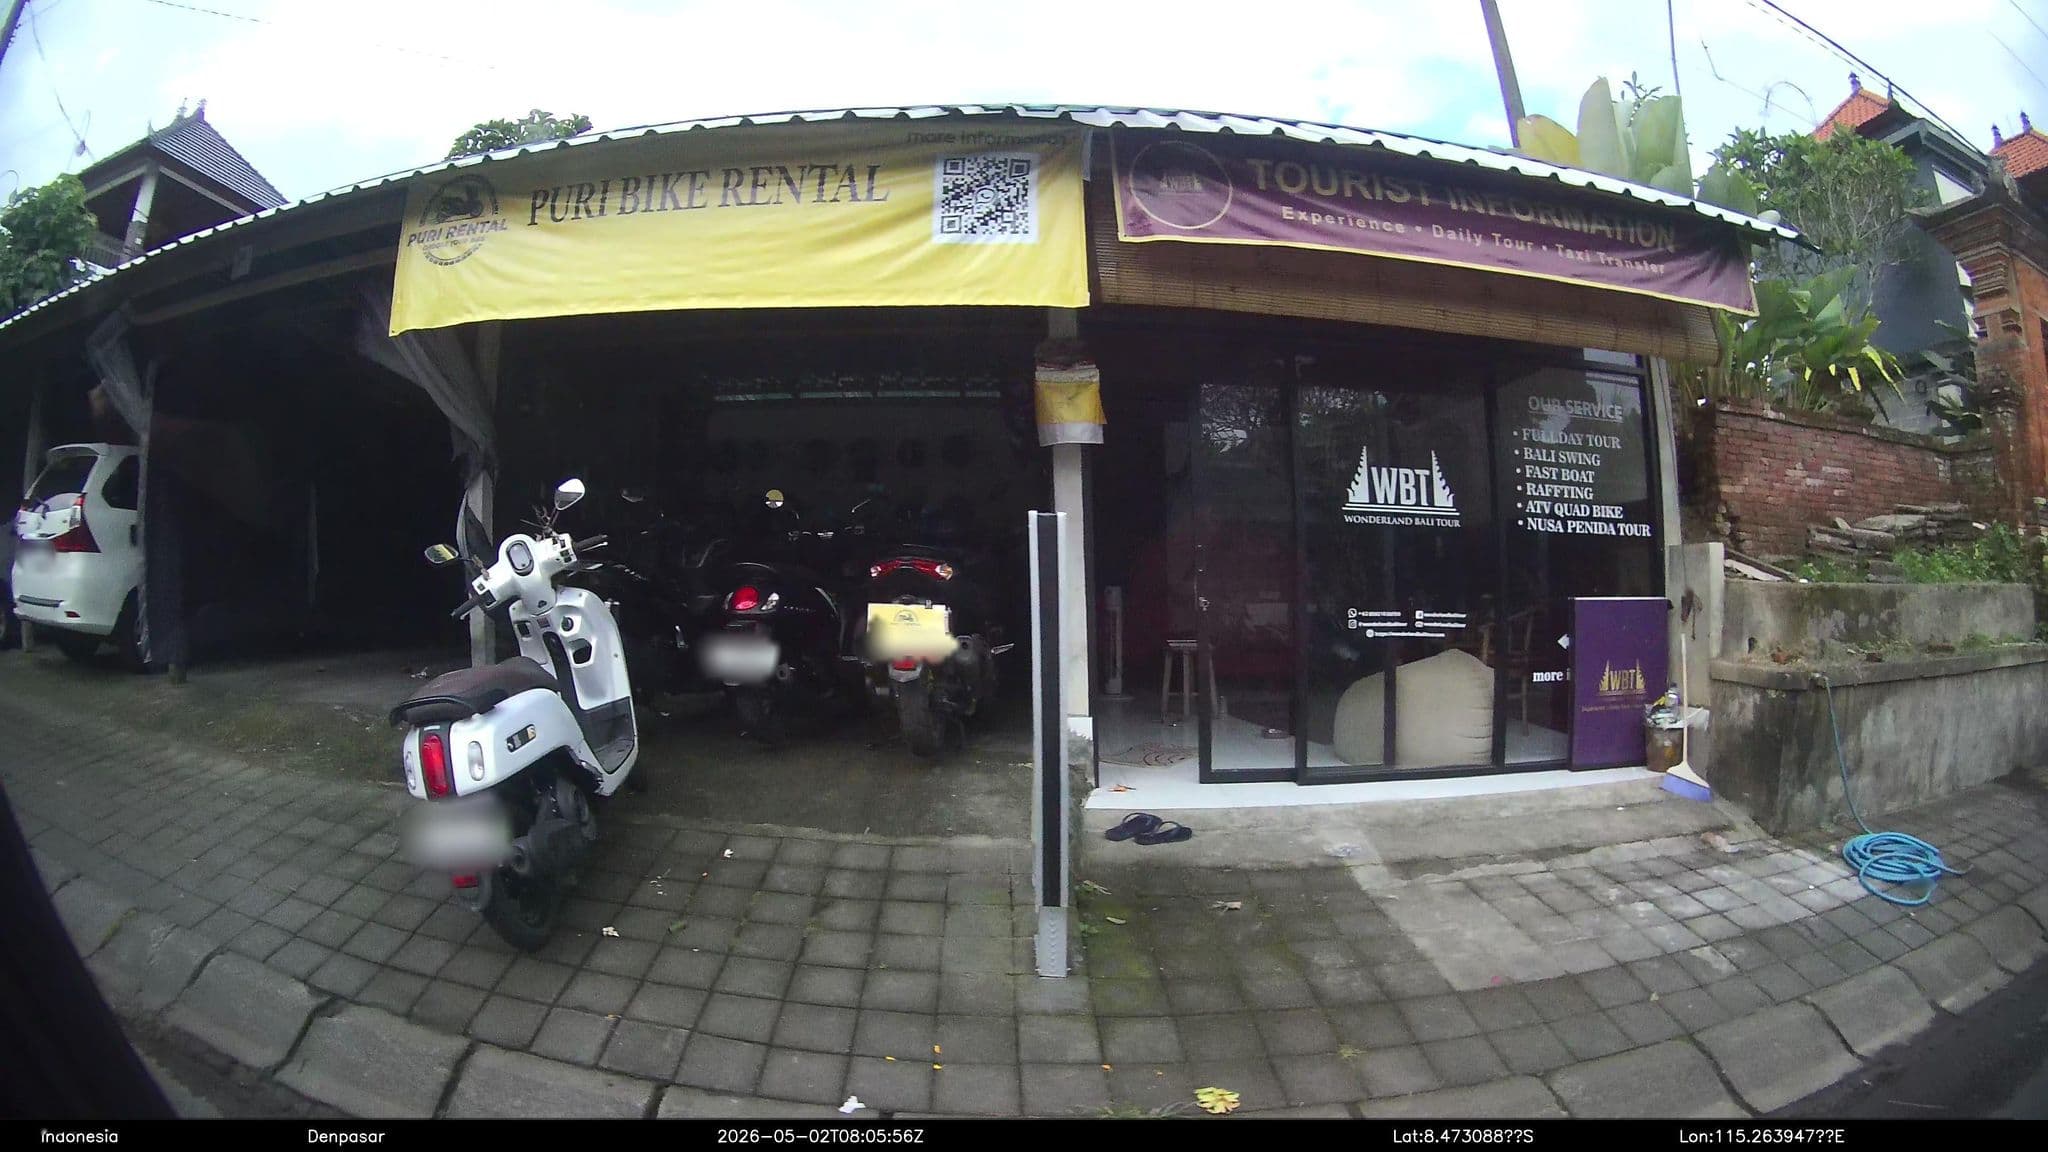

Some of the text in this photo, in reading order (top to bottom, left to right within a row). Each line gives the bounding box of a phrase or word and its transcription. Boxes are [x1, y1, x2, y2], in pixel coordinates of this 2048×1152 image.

[1247, 157, 1431, 207] TOURIST
[527, 163, 890, 226] PURI BIKE RENTAL
[407, 228, 442, 247] PURI
[446, 218, 507, 239] RENTAL
[1281, 205, 1405, 234] Experience
[1432, 224, 1483, 247] Daily
[1491, 233, 1534, 252] Tour
[1554, 243, 1591, 263] Taxi
[1565, 399, 1623, 421] SERVICE
[1586, 435, 1621, 449] TOUR
[1524, 447, 1600, 466] BALI SWING
[1525, 465, 1595, 483] FAST BOAT
[1371, 466, 1430, 506] WBT
[1526, 483, 1594, 500] RAFFTING
[1525, 500, 1624, 518] ATV QUAD BIKE
[1344, 515, 1461, 527] WONDERLAND BALI TOUR
[1527, 517, 1651, 537] NUSA PENIDA TOUR
[1533, 671, 1563, 682] more
[1610, 669, 1636, 690] WBT
